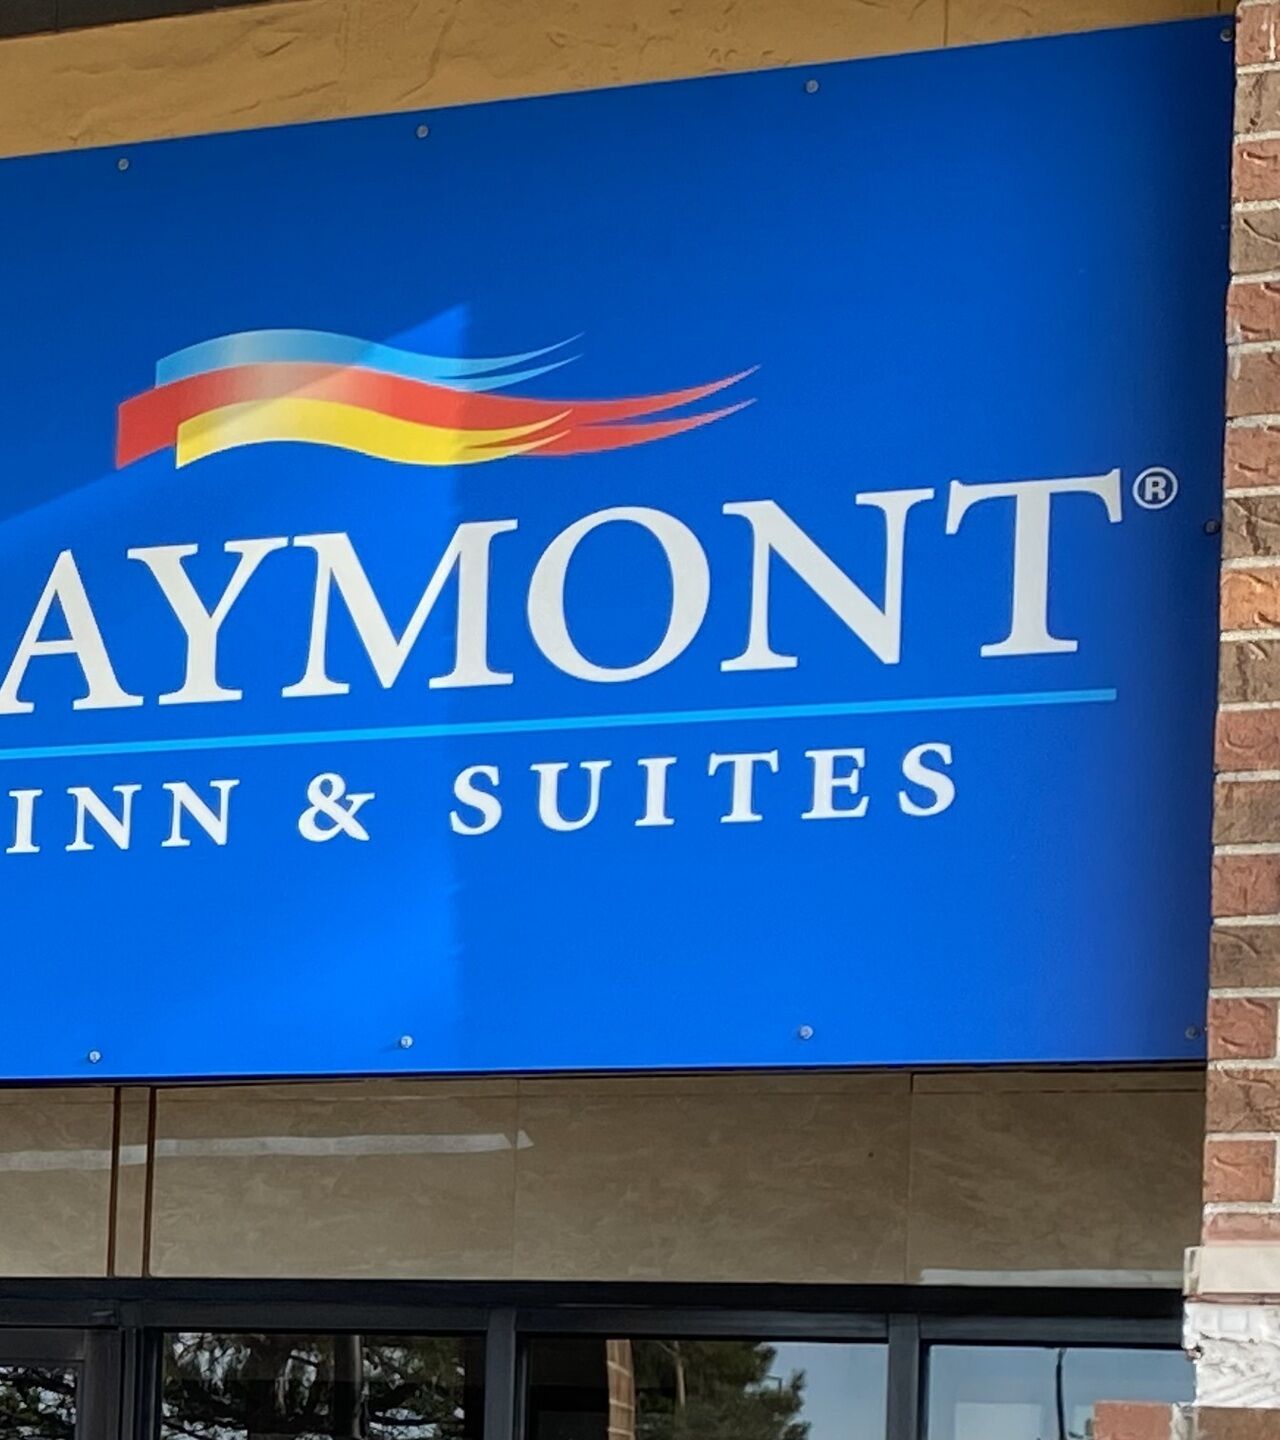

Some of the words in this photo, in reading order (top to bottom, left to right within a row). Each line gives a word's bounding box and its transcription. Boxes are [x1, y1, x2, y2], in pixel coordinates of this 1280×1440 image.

[6, 780, 238, 853] INN
[299, 773, 374, 842] &
[451, 743, 955, 835] SUITES
